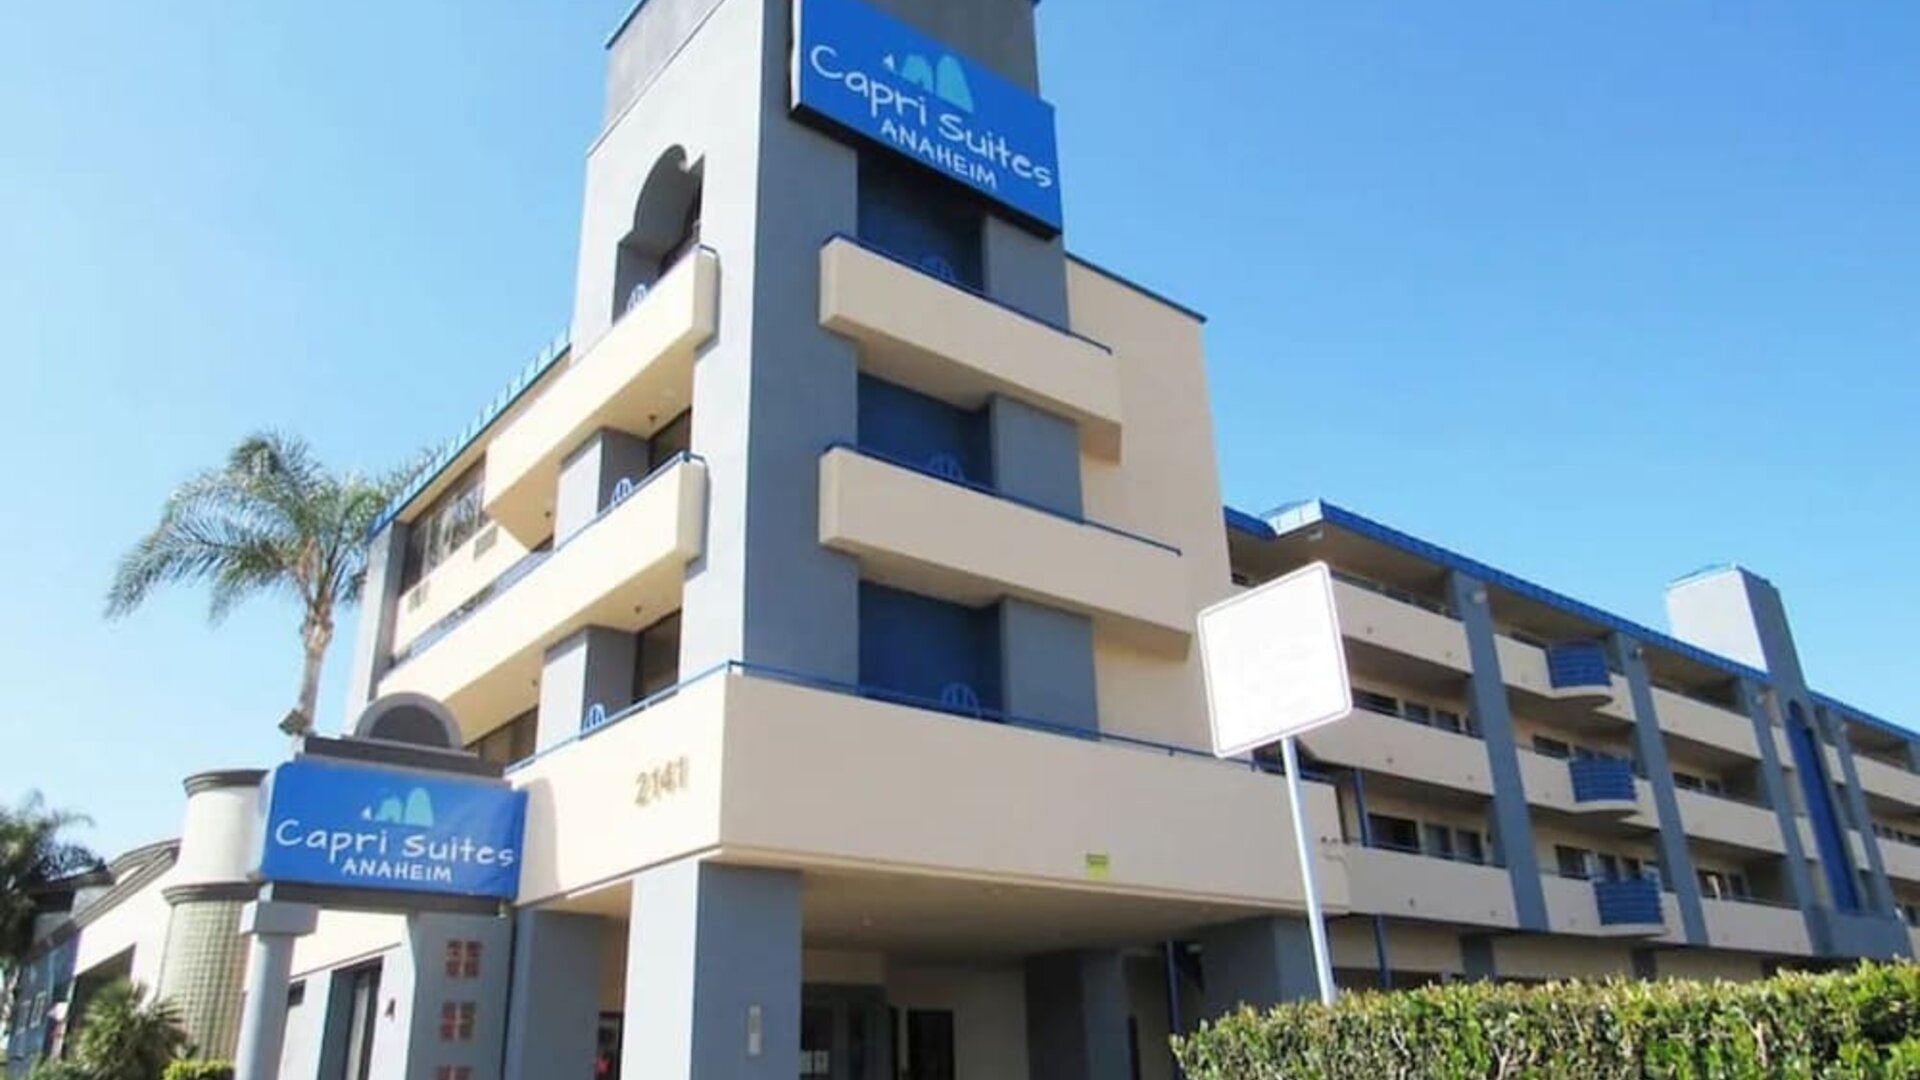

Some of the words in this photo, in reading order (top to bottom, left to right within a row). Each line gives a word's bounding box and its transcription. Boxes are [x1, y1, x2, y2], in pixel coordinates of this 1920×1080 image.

[810, 44, 927, 126] Capri
[938, 113, 1053, 188] Suites
[880, 118, 998, 189] ANAHEIM
[635, 757, 690, 807] 2141
[275, 818, 387, 864] Capri
[402, 832, 514, 867] Suites
[341, 858, 453, 883] ANAHEIM
